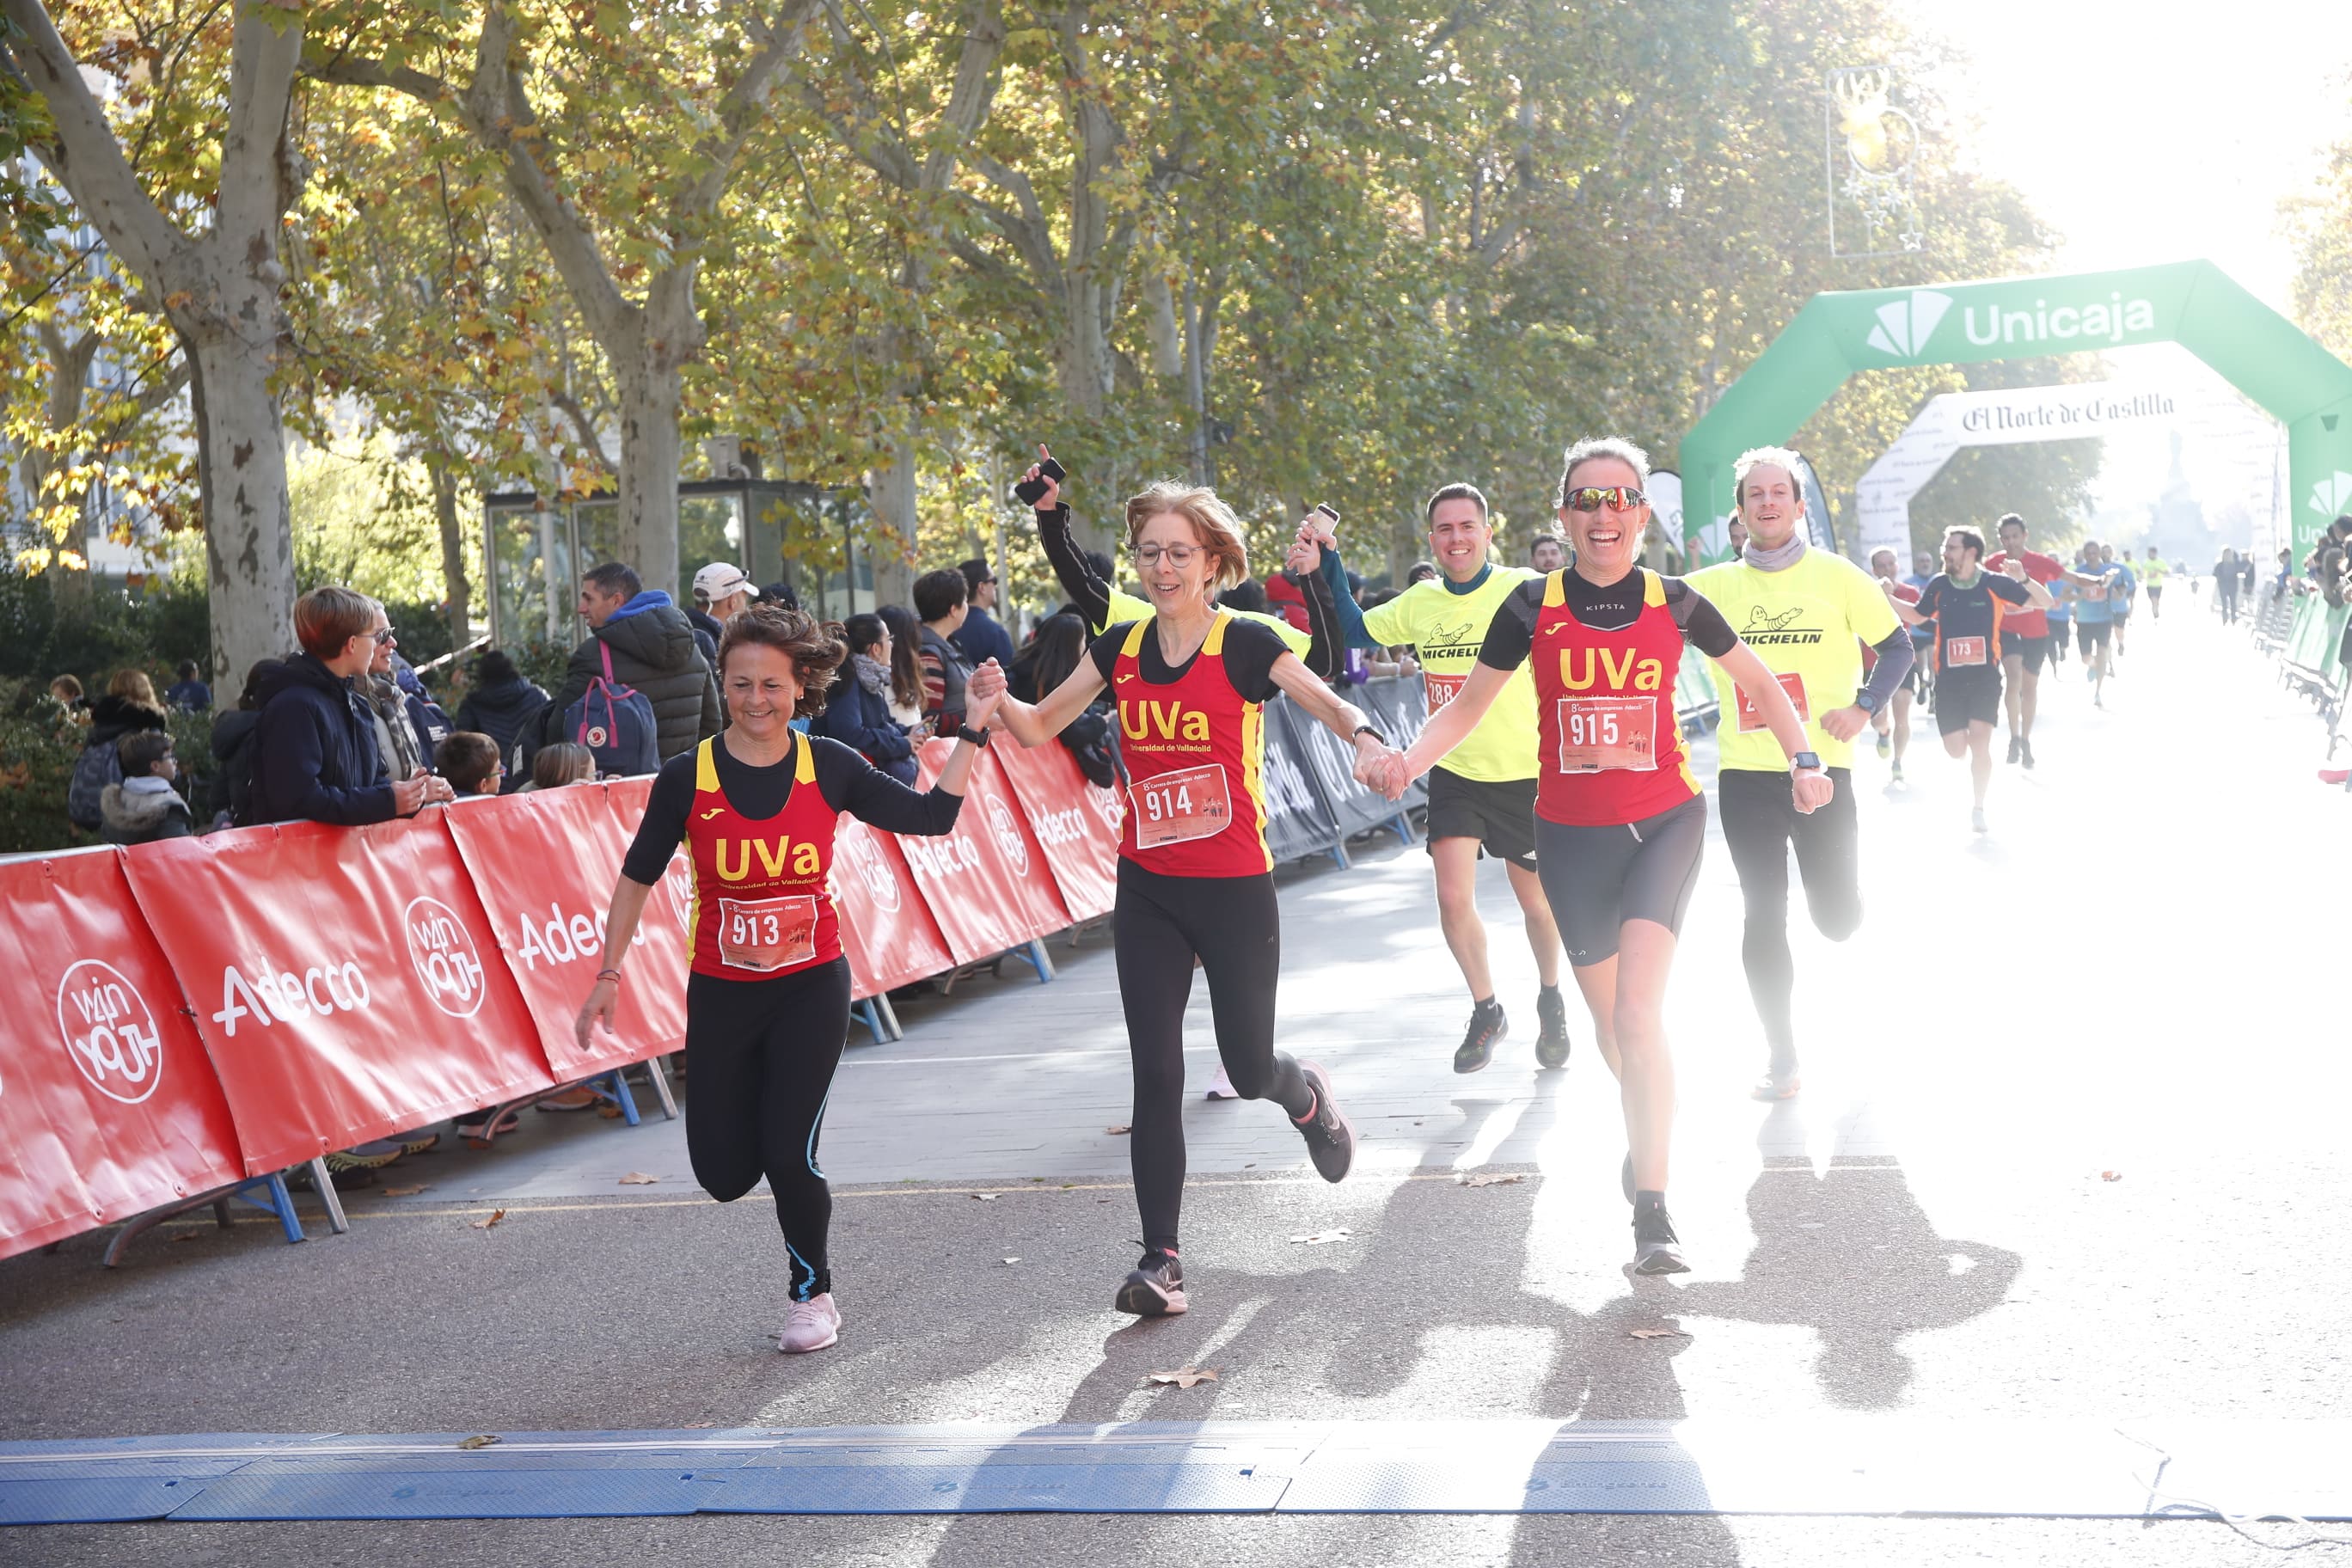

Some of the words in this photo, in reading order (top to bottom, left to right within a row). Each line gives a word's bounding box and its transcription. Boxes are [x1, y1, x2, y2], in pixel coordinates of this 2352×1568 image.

[1963, 291, 2154, 345] Unicaja
[1962, 407, 1991, 432] El
[1995, 404, 2053, 430] Norte
[2059, 403, 2081, 424] de
[2086, 393, 2175, 422] Castilla
[1423, 647, 1479, 659] MICHELI
[1559, 647, 1663, 690] UVa
[1952, 642, 1971, 656] 173
[1119, 701, 1210, 741] UVa
[1570, 714, 1619, 745] 915
[1167, 744, 1175, 752] de
[1176, 744, 1211, 753] Valladolid
[1145, 786, 1193, 821] 914
[1032, 803, 1088, 845] Adecco
[716, 836, 820, 881] UVa
[906, 834, 980, 880] Adecco
[732, 914, 780, 946] 913
[212, 955, 371, 1037] Adecco
